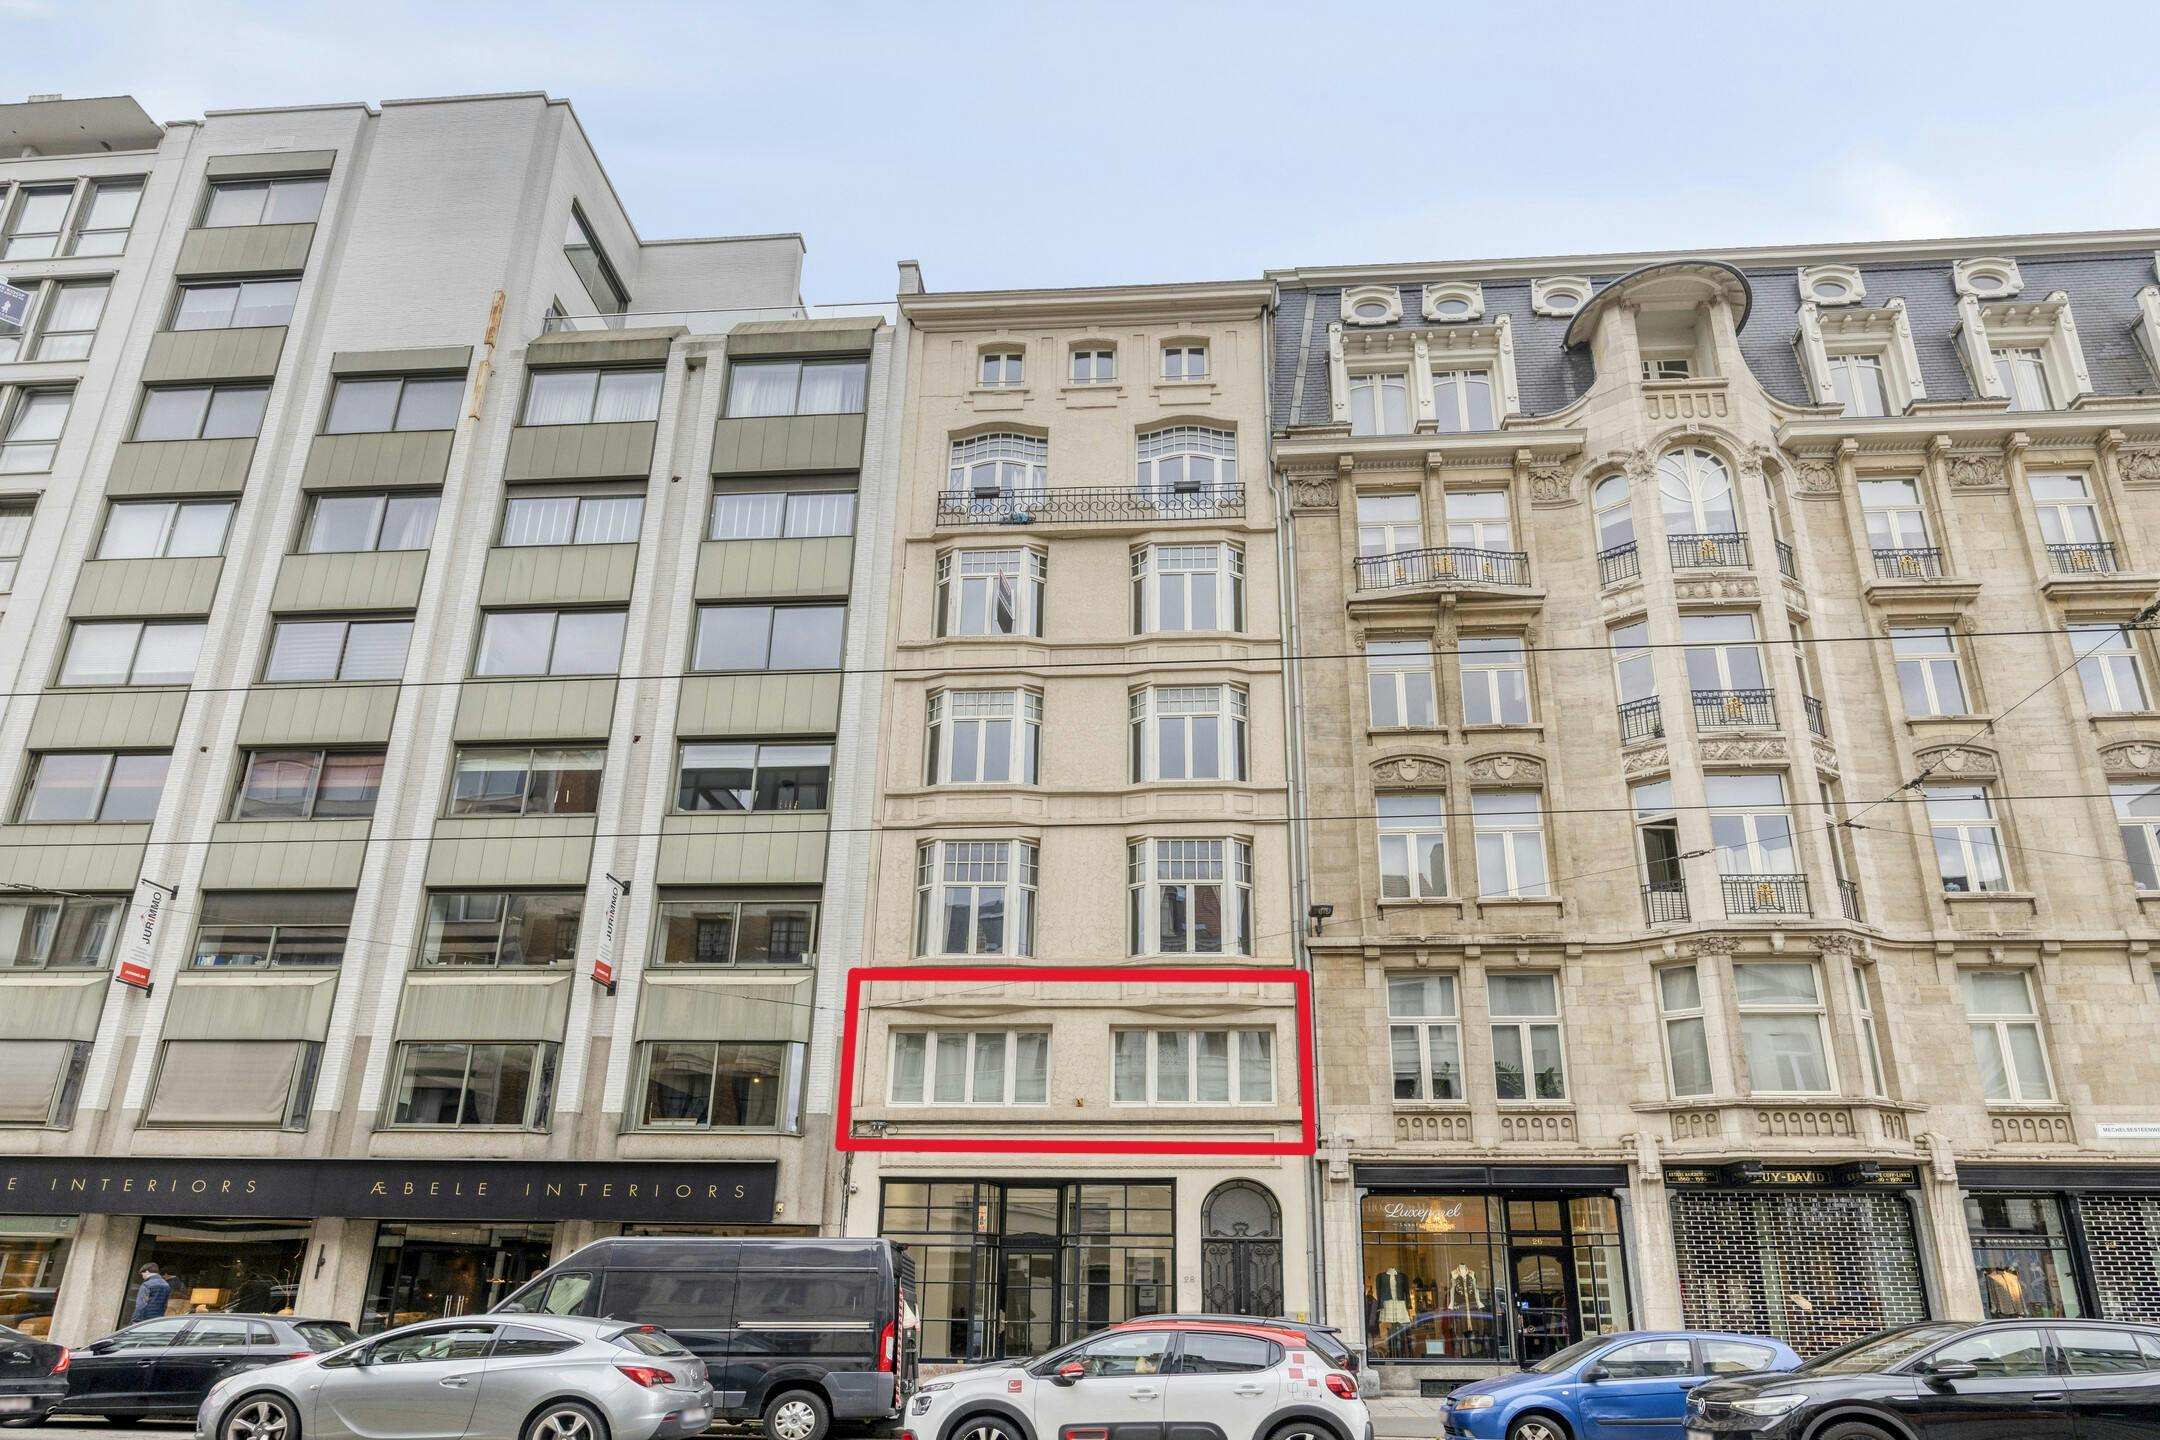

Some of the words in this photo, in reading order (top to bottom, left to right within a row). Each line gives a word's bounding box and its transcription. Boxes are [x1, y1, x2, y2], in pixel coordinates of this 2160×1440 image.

[141, 891, 162, 945] JURIMMO
[606, 887, 618, 941] JURIMMO
[51, 1178, 256, 1193] INTERIORS
[1755, 1172, 1825, 1182] UY-DAVID
[370, 1181, 488, 1196] ÆBELE
[525, 1183, 745, 1198] INTERIORS
